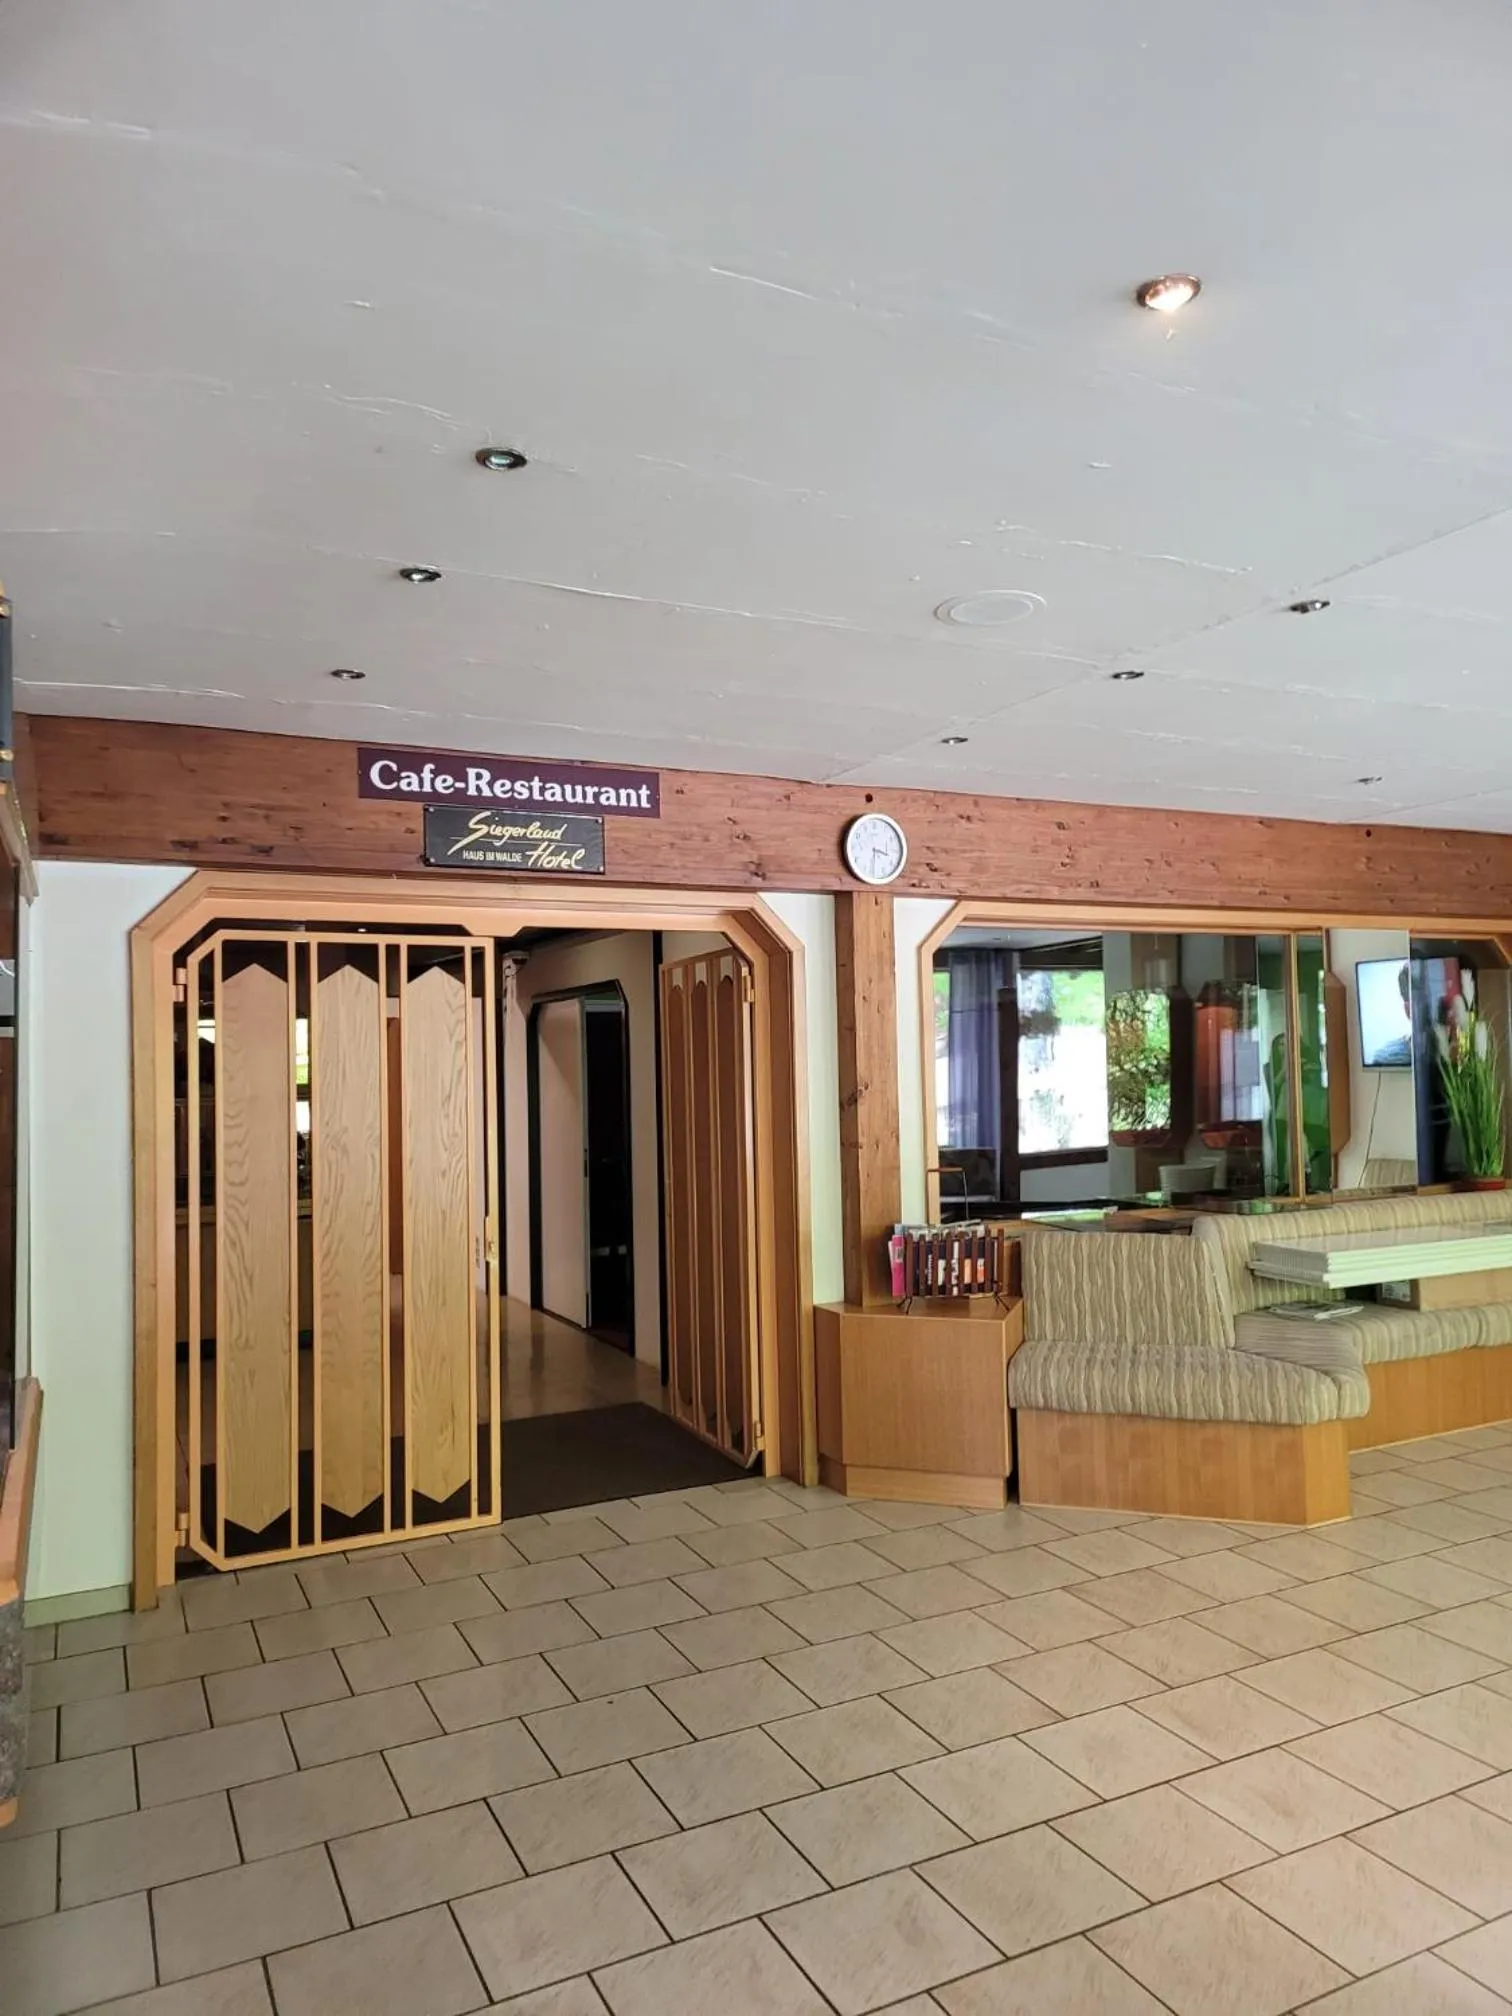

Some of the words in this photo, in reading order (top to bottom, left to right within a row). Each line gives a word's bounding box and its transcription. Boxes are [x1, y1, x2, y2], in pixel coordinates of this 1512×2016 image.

[369, 760, 651, 809] Cafe-Restaurant
[447, 810, 568, 856] Siegerland
[462, 849, 485, 861] HAUS
[495, 850, 523, 863] WALDE
[525, 841, 586, 870] Hotel
